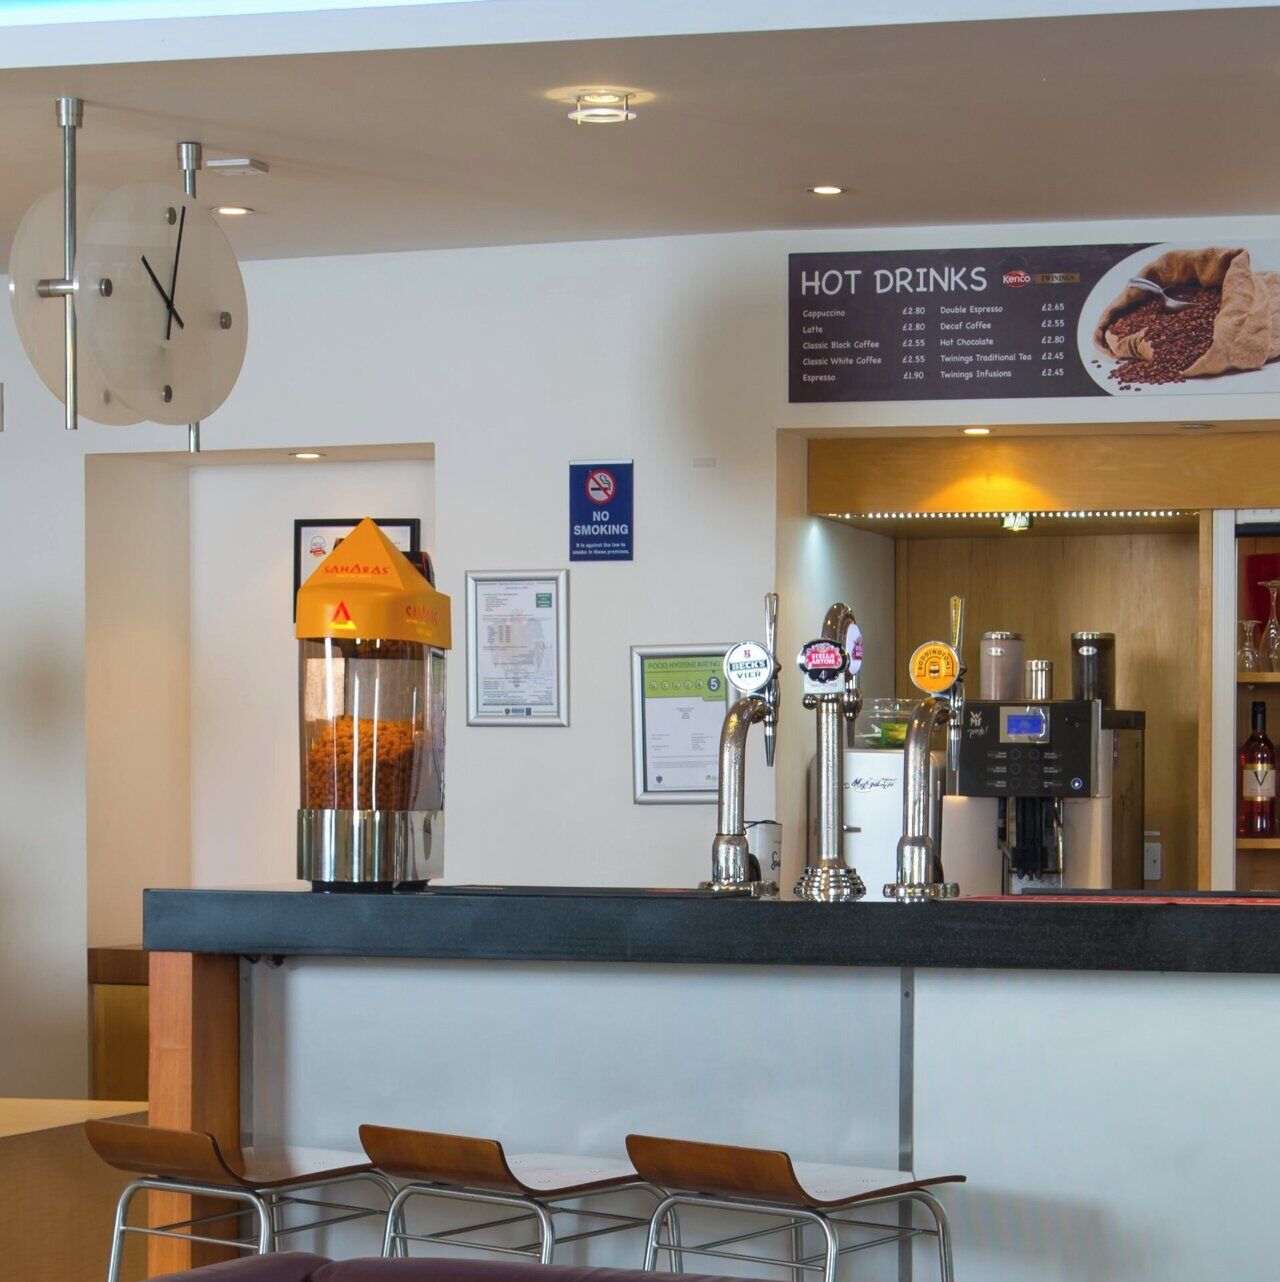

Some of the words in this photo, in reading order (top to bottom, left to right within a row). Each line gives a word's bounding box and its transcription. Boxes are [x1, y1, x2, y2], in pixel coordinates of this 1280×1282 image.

[801, 269, 862, 296] HOT
[874, 266, 988, 294] DRINKS
[1002, 273, 1031, 285] Kenco
[1040, 273, 1076, 282] TWININGS
[802, 309, 846, 319] Cappuccino
[902, 307, 926, 315] £2.80
[940, 306, 967, 314] Double
[970, 305, 1003, 315] Espresso
[1041, 303, 1065, 311] £2.65
[802, 325, 823, 334] Latte
[902, 323, 926, 332] £2.80
[940, 322, 963, 330] Decaf
[965, 321, 991, 330] Coffee
[1041, 319, 1065, 328] £2.55
[802, 341, 828, 350] Classic
[831, 340, 851, 349] Black
[853, 339, 880, 349] Coffee
[902, 339, 926, 347] £2.55
[940, 338, 954, 346] Hot
[956, 338, 994, 347] Chocolate
[1041, 336, 1065, 344] £2.80
[802, 357, 828, 366] Classic
[830, 356, 853, 365] White
[856, 355, 882, 365] Coffee
[902, 355, 926, 363] £2.55
[940, 354, 973, 364] Twinings
[976, 353, 1016, 362] Traditional
[1019, 353, 1032, 361] Tea
[1041, 352, 1065, 360] £2.45
[802, 373, 836, 383] Espresso
[903, 371, 924, 380] £1.90
[940, 370, 973, 380] Twinings
[976, 370, 1012, 378] Infusions
[1041, 369, 1065, 377] £2.45
[592, 510, 610, 521] NO
[573, 524, 629, 536] SMOKING
[323, 563, 391, 575] SAHARAS
[647, 662, 668, 670] FOOD
[669, 661, 697, 669] HYGIENE
[697, 660, 721, 668] RATING
[918, 650, 951, 671] BODDINGTONS
[736, 671, 762, 680] VIER
[710, 678, 718, 690] 5
